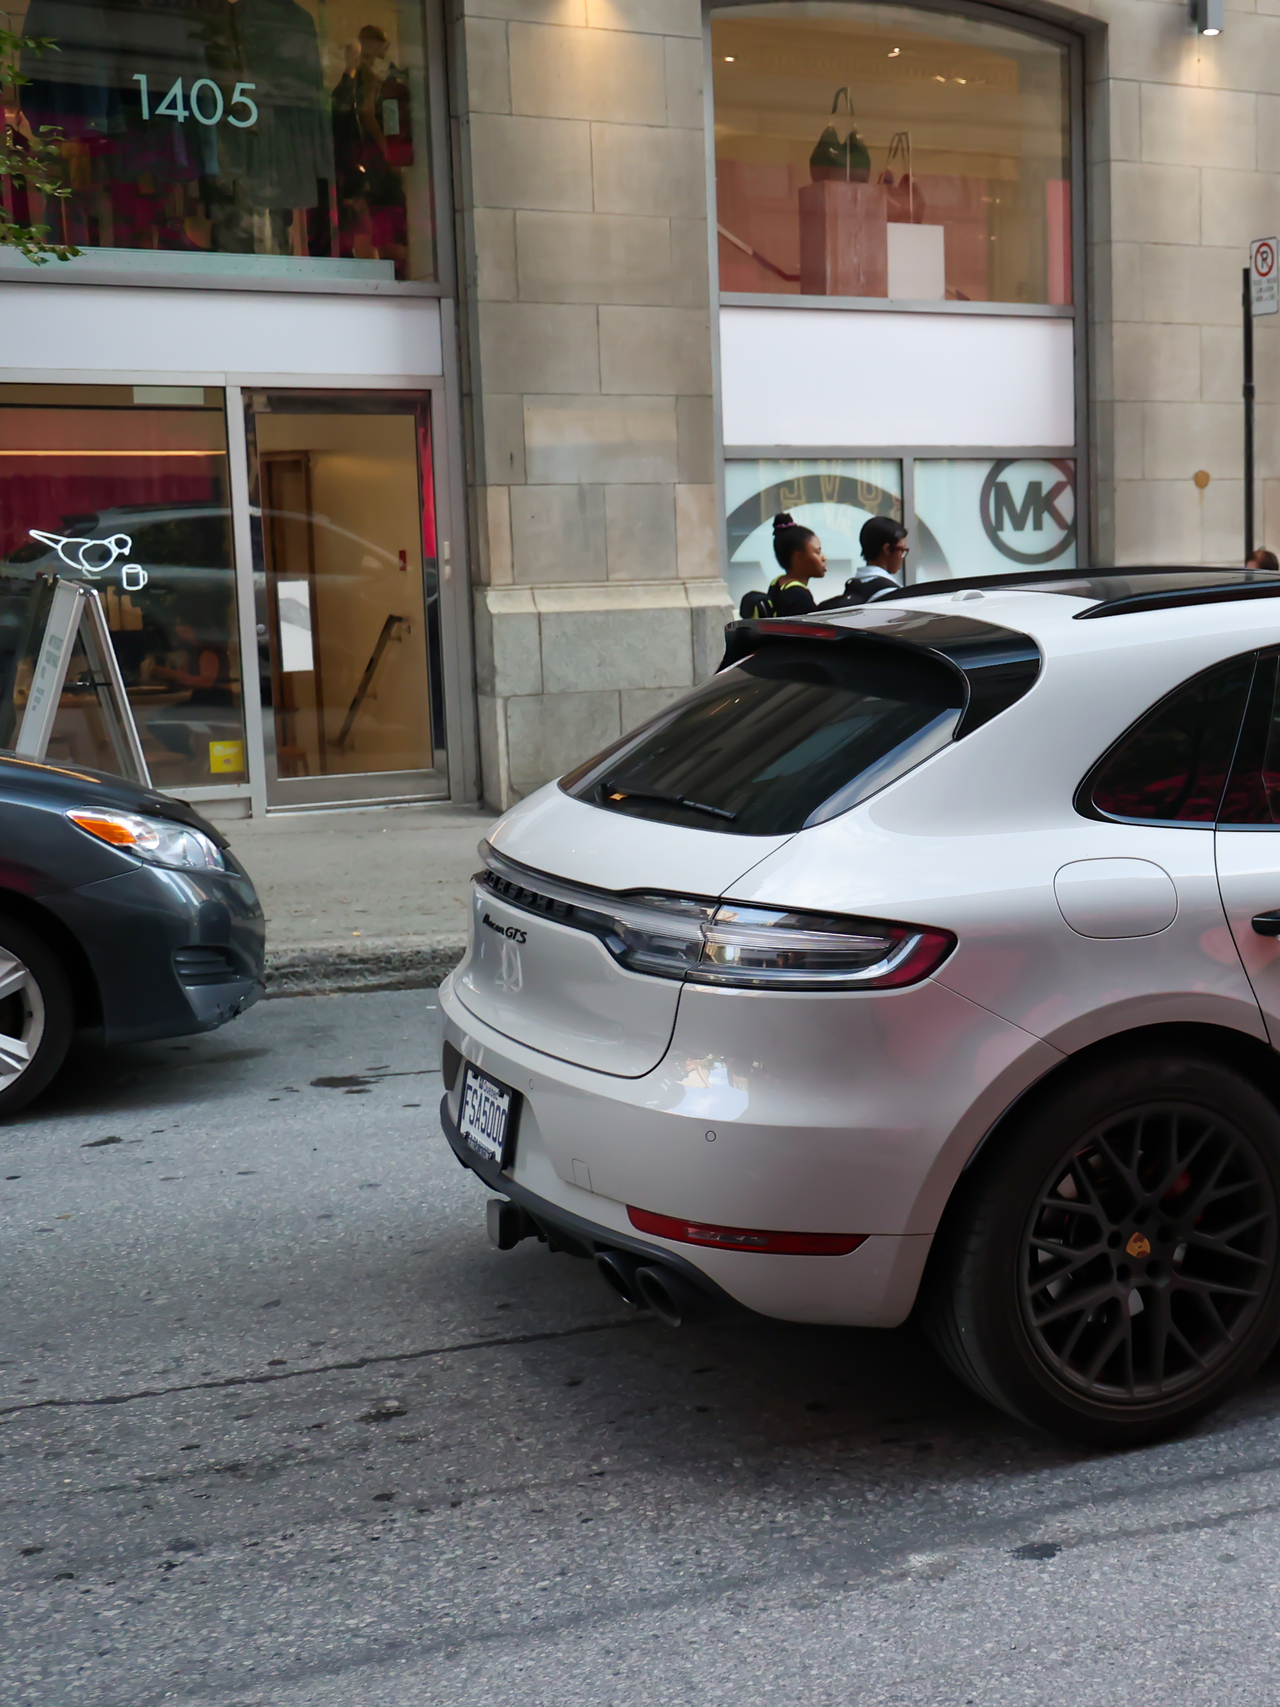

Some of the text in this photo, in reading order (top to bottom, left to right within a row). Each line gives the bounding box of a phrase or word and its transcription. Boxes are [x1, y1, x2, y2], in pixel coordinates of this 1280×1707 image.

[132, 73, 259, 128] 1405
[993, 481, 1070, 531] MK
[505, 926, 528, 944] GTS
[463, 1084, 508, 1148] FSA5000
